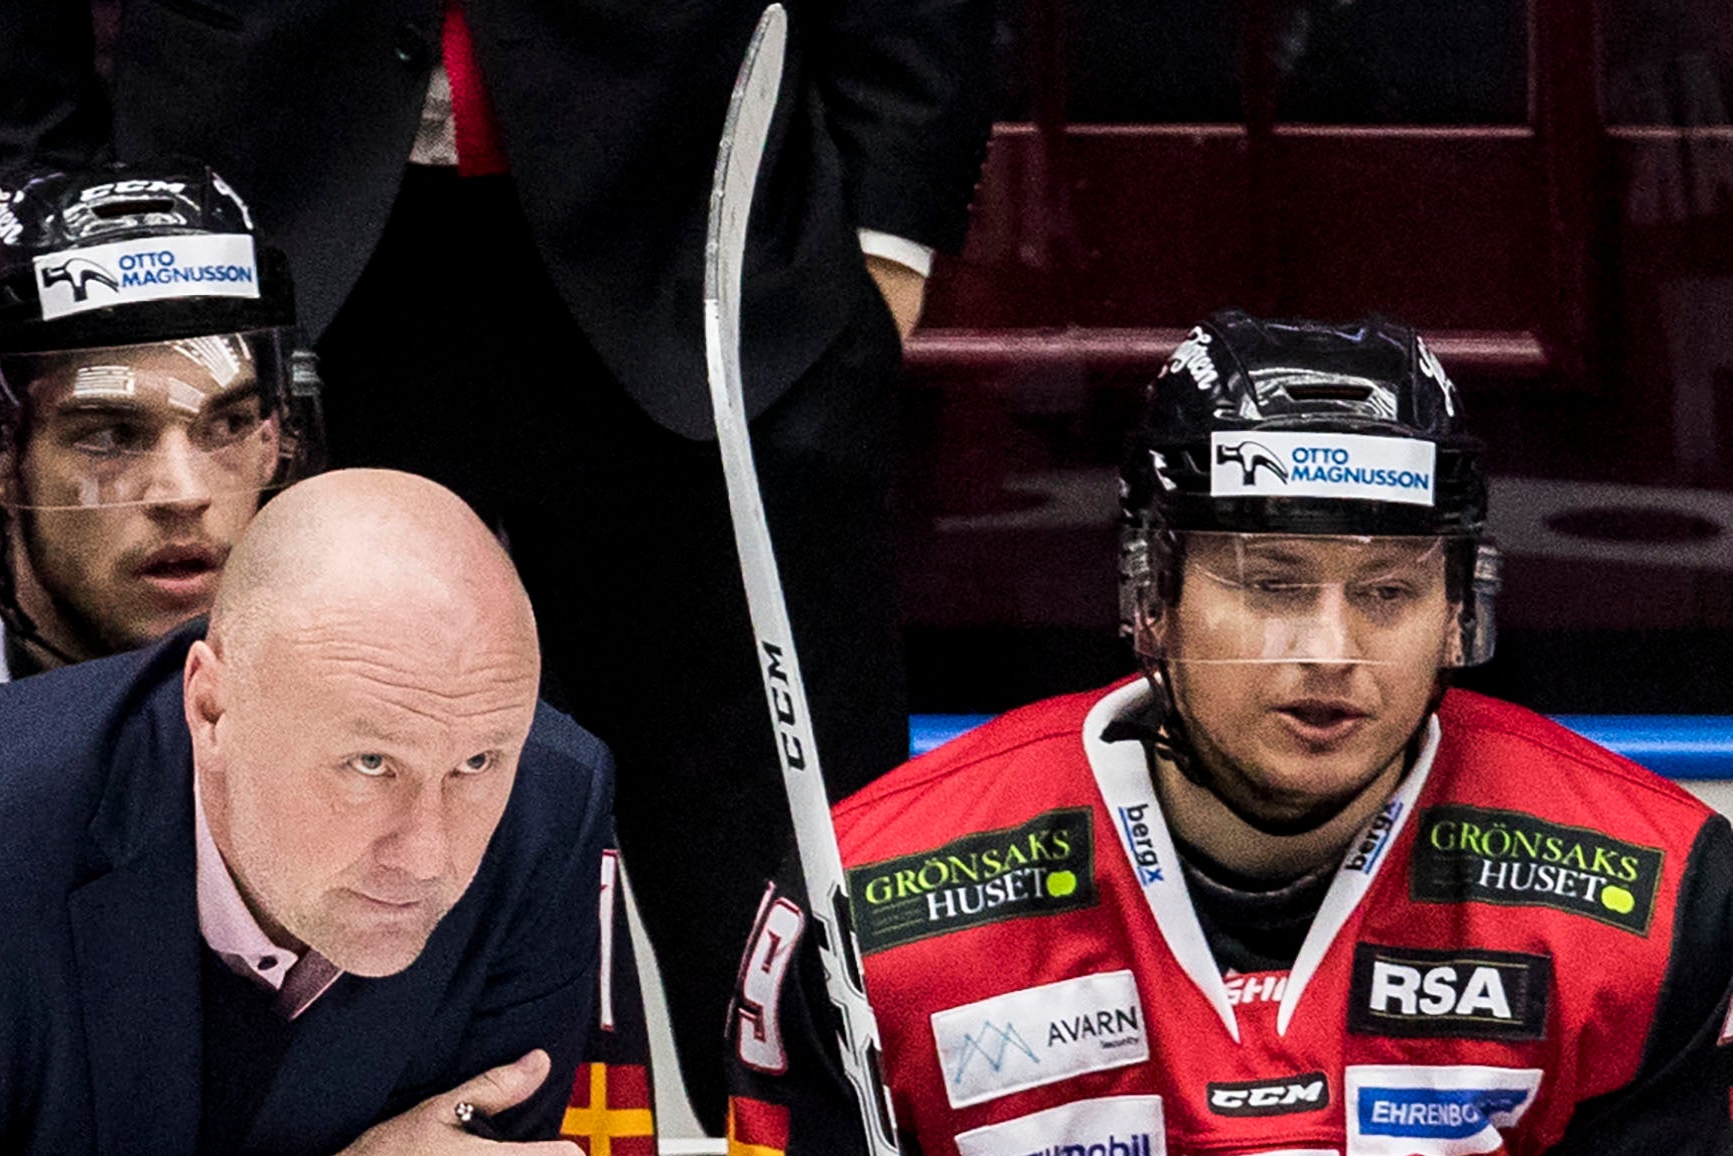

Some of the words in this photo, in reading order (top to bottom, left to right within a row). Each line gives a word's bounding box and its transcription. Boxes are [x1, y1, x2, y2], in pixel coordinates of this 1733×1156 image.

[118, 250, 175, 271] OTTO
[121, 265, 253, 288] MAGNUSSON
[1292, 446, 1349, 465] OTTO
[1291, 466, 1430, 490] MAGNUSSON
[761, 640, 806, 771] CCM
[1119, 803, 1165, 888] bergx
[1431, 821, 1638, 883] GRÖNSAKS
[866, 831, 1071, 904] GRÖNSAKS
[1479, 859, 1607, 902] HUSET
[926, 867, 1048, 922] HUSET
[1369, 962, 1512, 1018] RSA
[1047, 1006, 1139, 1047] AVARN
[1210, 1080, 1325, 1108] CCM
